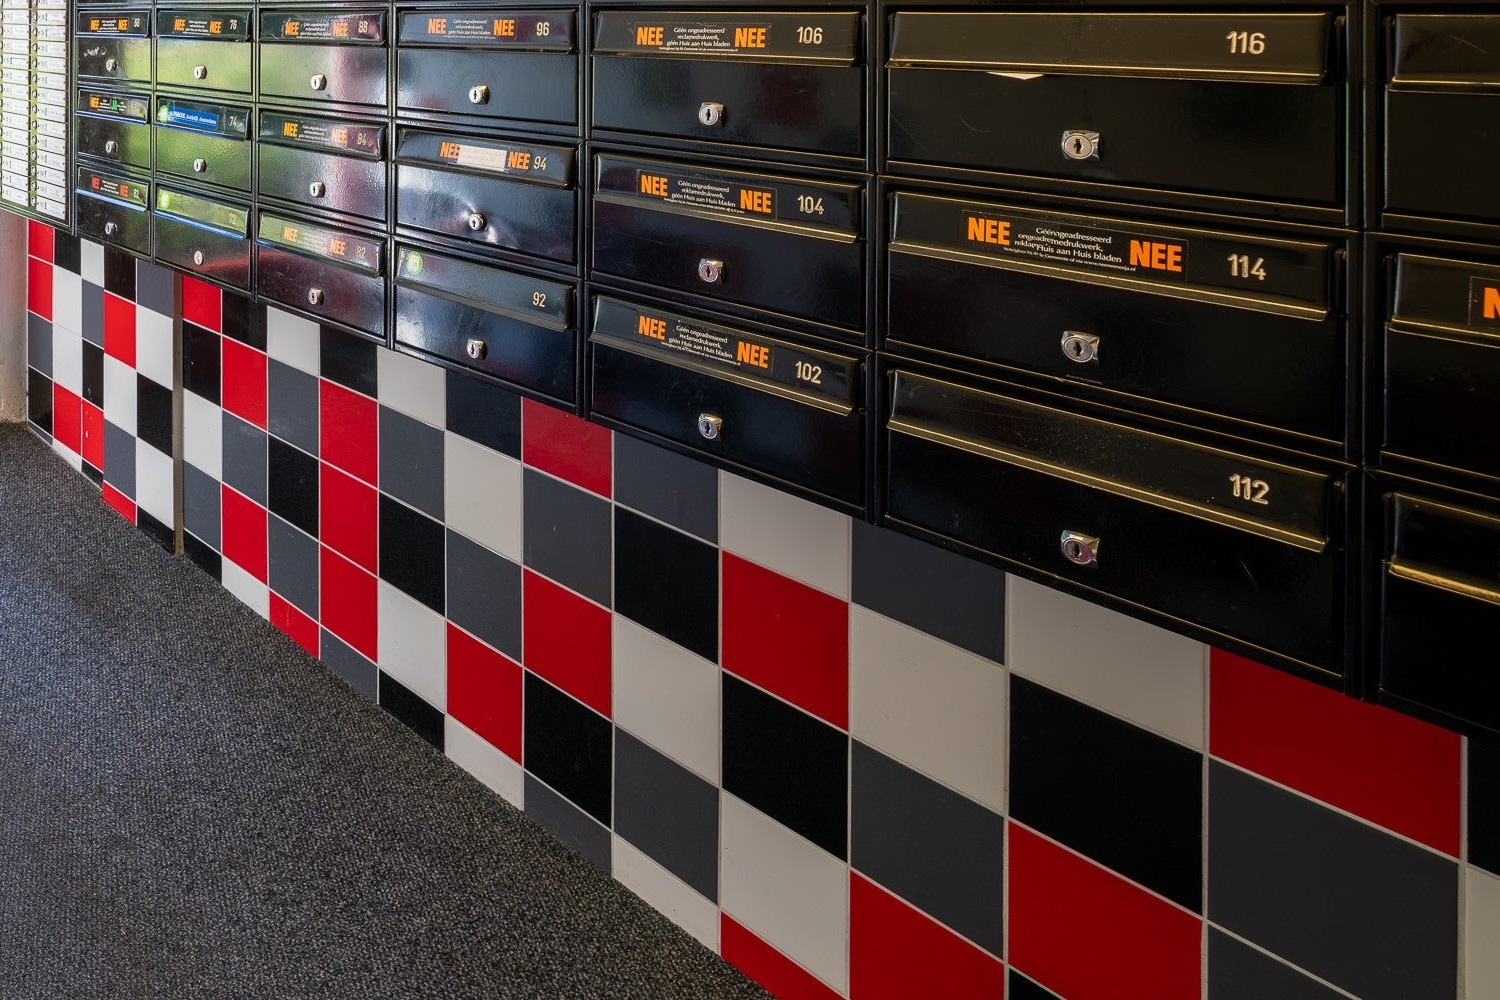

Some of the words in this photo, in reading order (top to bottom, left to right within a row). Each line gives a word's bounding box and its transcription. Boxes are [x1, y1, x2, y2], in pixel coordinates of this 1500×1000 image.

[174, 18, 186, 31] NEE
[210, 20, 222, 34] NEE
[285, 22, 299, 36] NEE
[332, 22, 348, 36] NEE
[428, 18, 446, 34] NEE
[493, 19, 514, 36] NEE
[536, 22, 550, 36] 96
[637, 26, 664, 46] NEE
[734, 28, 766, 48] NEE
[796, 26, 823, 44] 106
[1226, 30, 1265, 55] 116
[284, 122, 298, 138] NEE
[331, 128, 348, 144] NEE
[358, 132, 367, 146] 84
[440, 142, 460, 160] NEE
[508, 152, 530, 170] NEE
[534, 155, 547, 170] 94
[641, 174, 668, 197] NEE
[740, 189, 772, 214] NEE
[798, 194, 824, 215] 104
[284, 226, 298, 243] NEE
[968, 216, 1010, 246] NEE
[330, 238, 346, 256] NEE
[1056, 248, 1071, 256] aan
[1074, 250, 1092, 258] Huis
[1094, 252, 1122, 263] bladen
[1130, 239, 1182, 272] NEE
[1227, 253, 1267, 282] 114
[532, 292, 546, 308] 92
[638, 316, 667, 341] NEE
[737, 340, 769, 369] NEE
[796, 360, 822, 384] 102
[1229, 472, 1270, 506] 112
